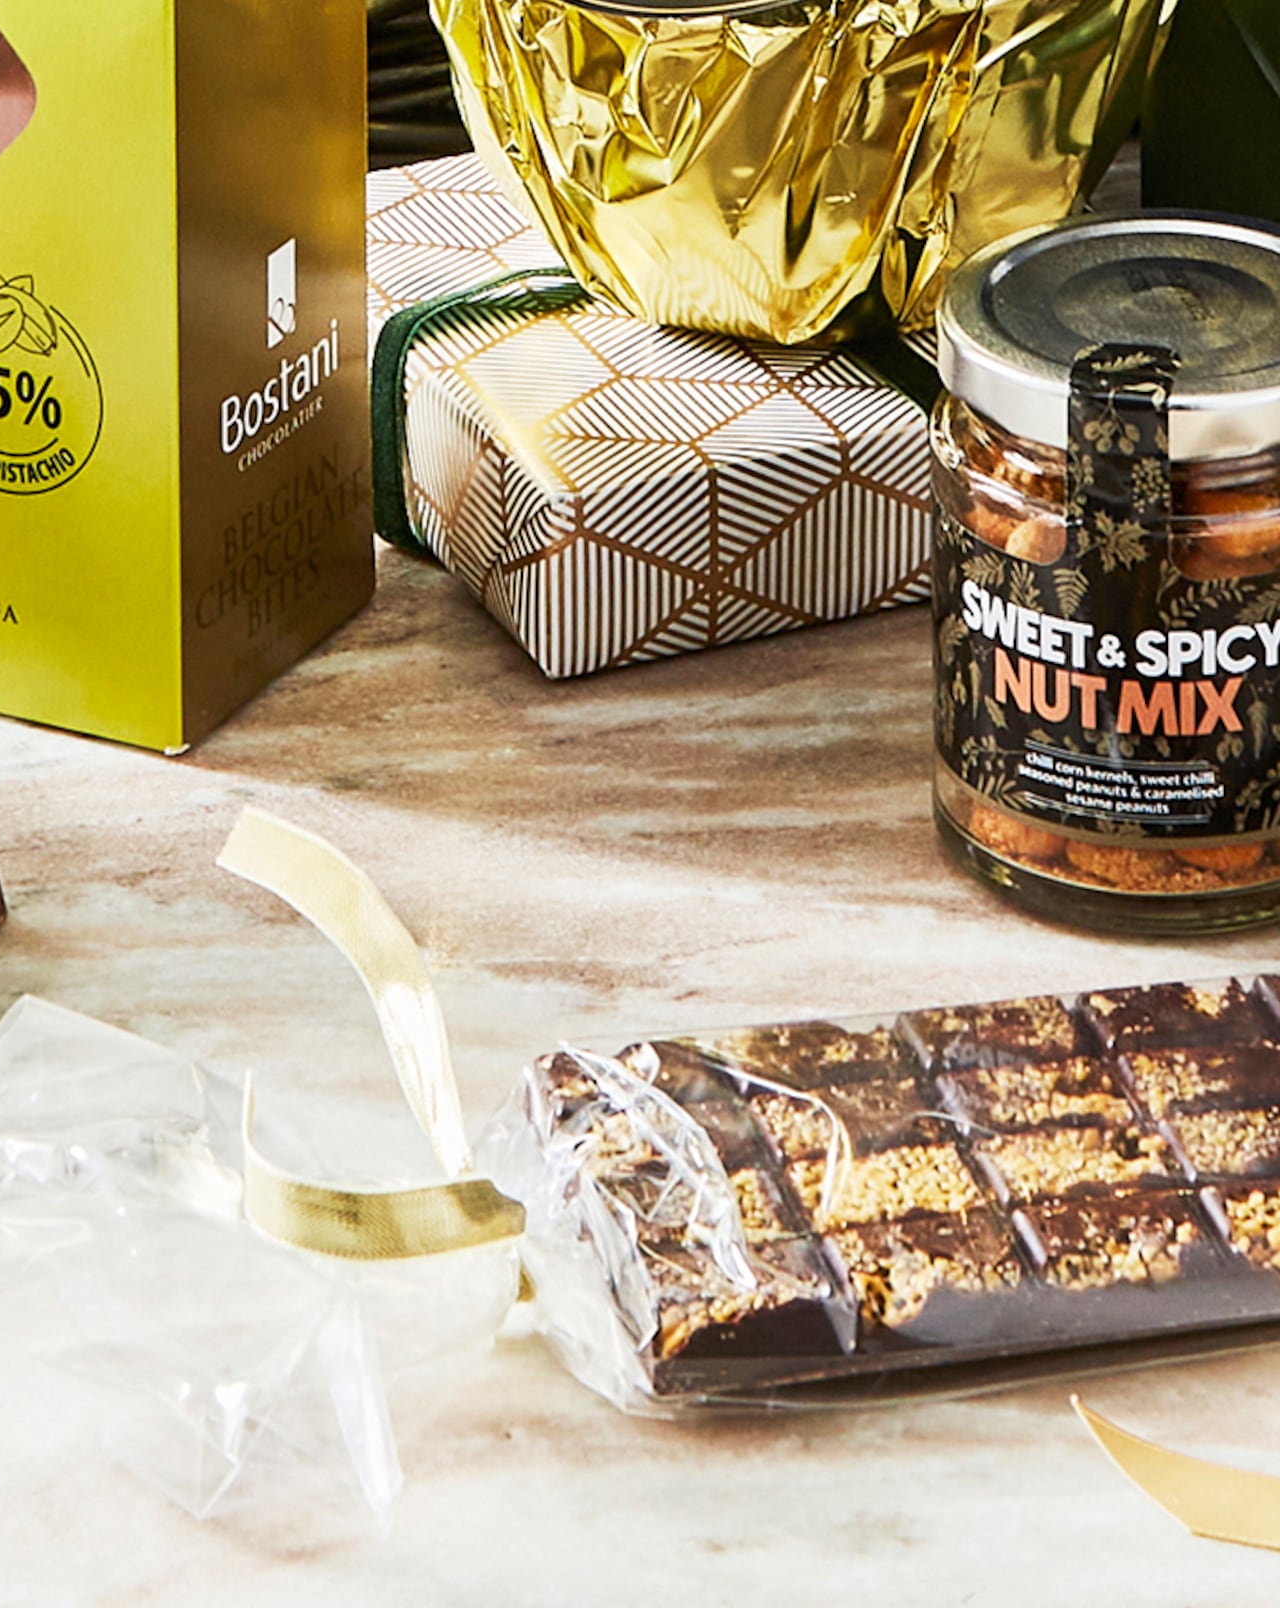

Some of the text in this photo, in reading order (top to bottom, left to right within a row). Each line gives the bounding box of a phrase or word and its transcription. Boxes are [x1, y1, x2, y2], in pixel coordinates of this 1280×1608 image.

[219, 317, 340, 456] Bostani
[237, 395, 324, 473] CHOCOLATIER
[223, 442, 339, 566] BELGIAN
[247, 550, 321, 638] BITES
[960, 578, 1094, 669] SWEET
[1096, 633, 1128, 669] &
[994, 646, 1245, 737] NUT MIX
[1018, 763, 1225, 801] seasoned peanuts & caramelised
[1055, 760, 1084, 777] corn
[1085, 764, 1138, 786] kernels,
[1139, 773, 1181, 787] sweet
[1182, 771, 1216, 785] chilli
[1064, 792, 1170, 815] sesame peanuts
